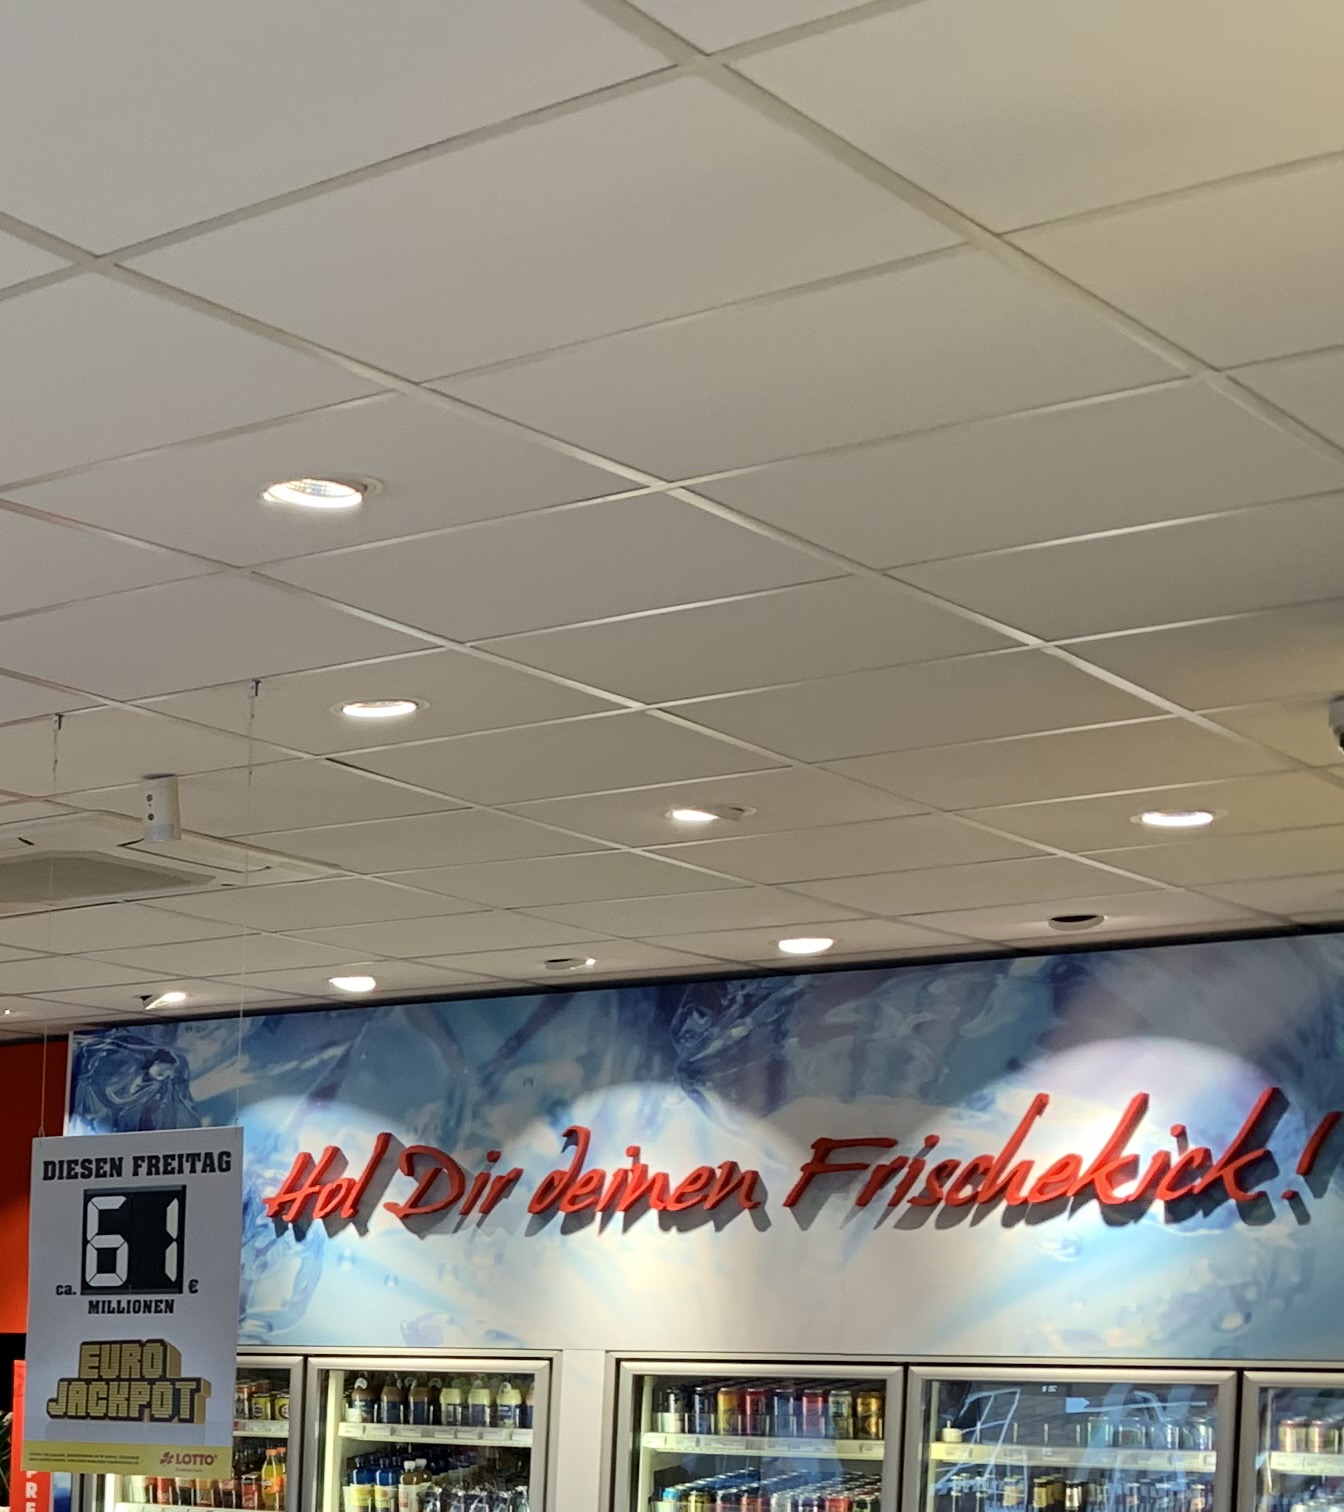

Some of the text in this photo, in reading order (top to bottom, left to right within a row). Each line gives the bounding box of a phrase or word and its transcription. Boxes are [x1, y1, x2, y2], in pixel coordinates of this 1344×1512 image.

[42, 1151, 232, 1181] DIESEN FREITAG
[263, 1087, 1342, 1222] Hol Dir deinen Frischekick!
[55, 1195, 199, 1297] ca. 61 €
[88, 1299, 175, 1314] MILLIONEN
[80, 1341, 166, 1379] EURO
[47, 1379, 198, 1420] JACKPOT
[175, 1453, 215, 1466] LOTTO
